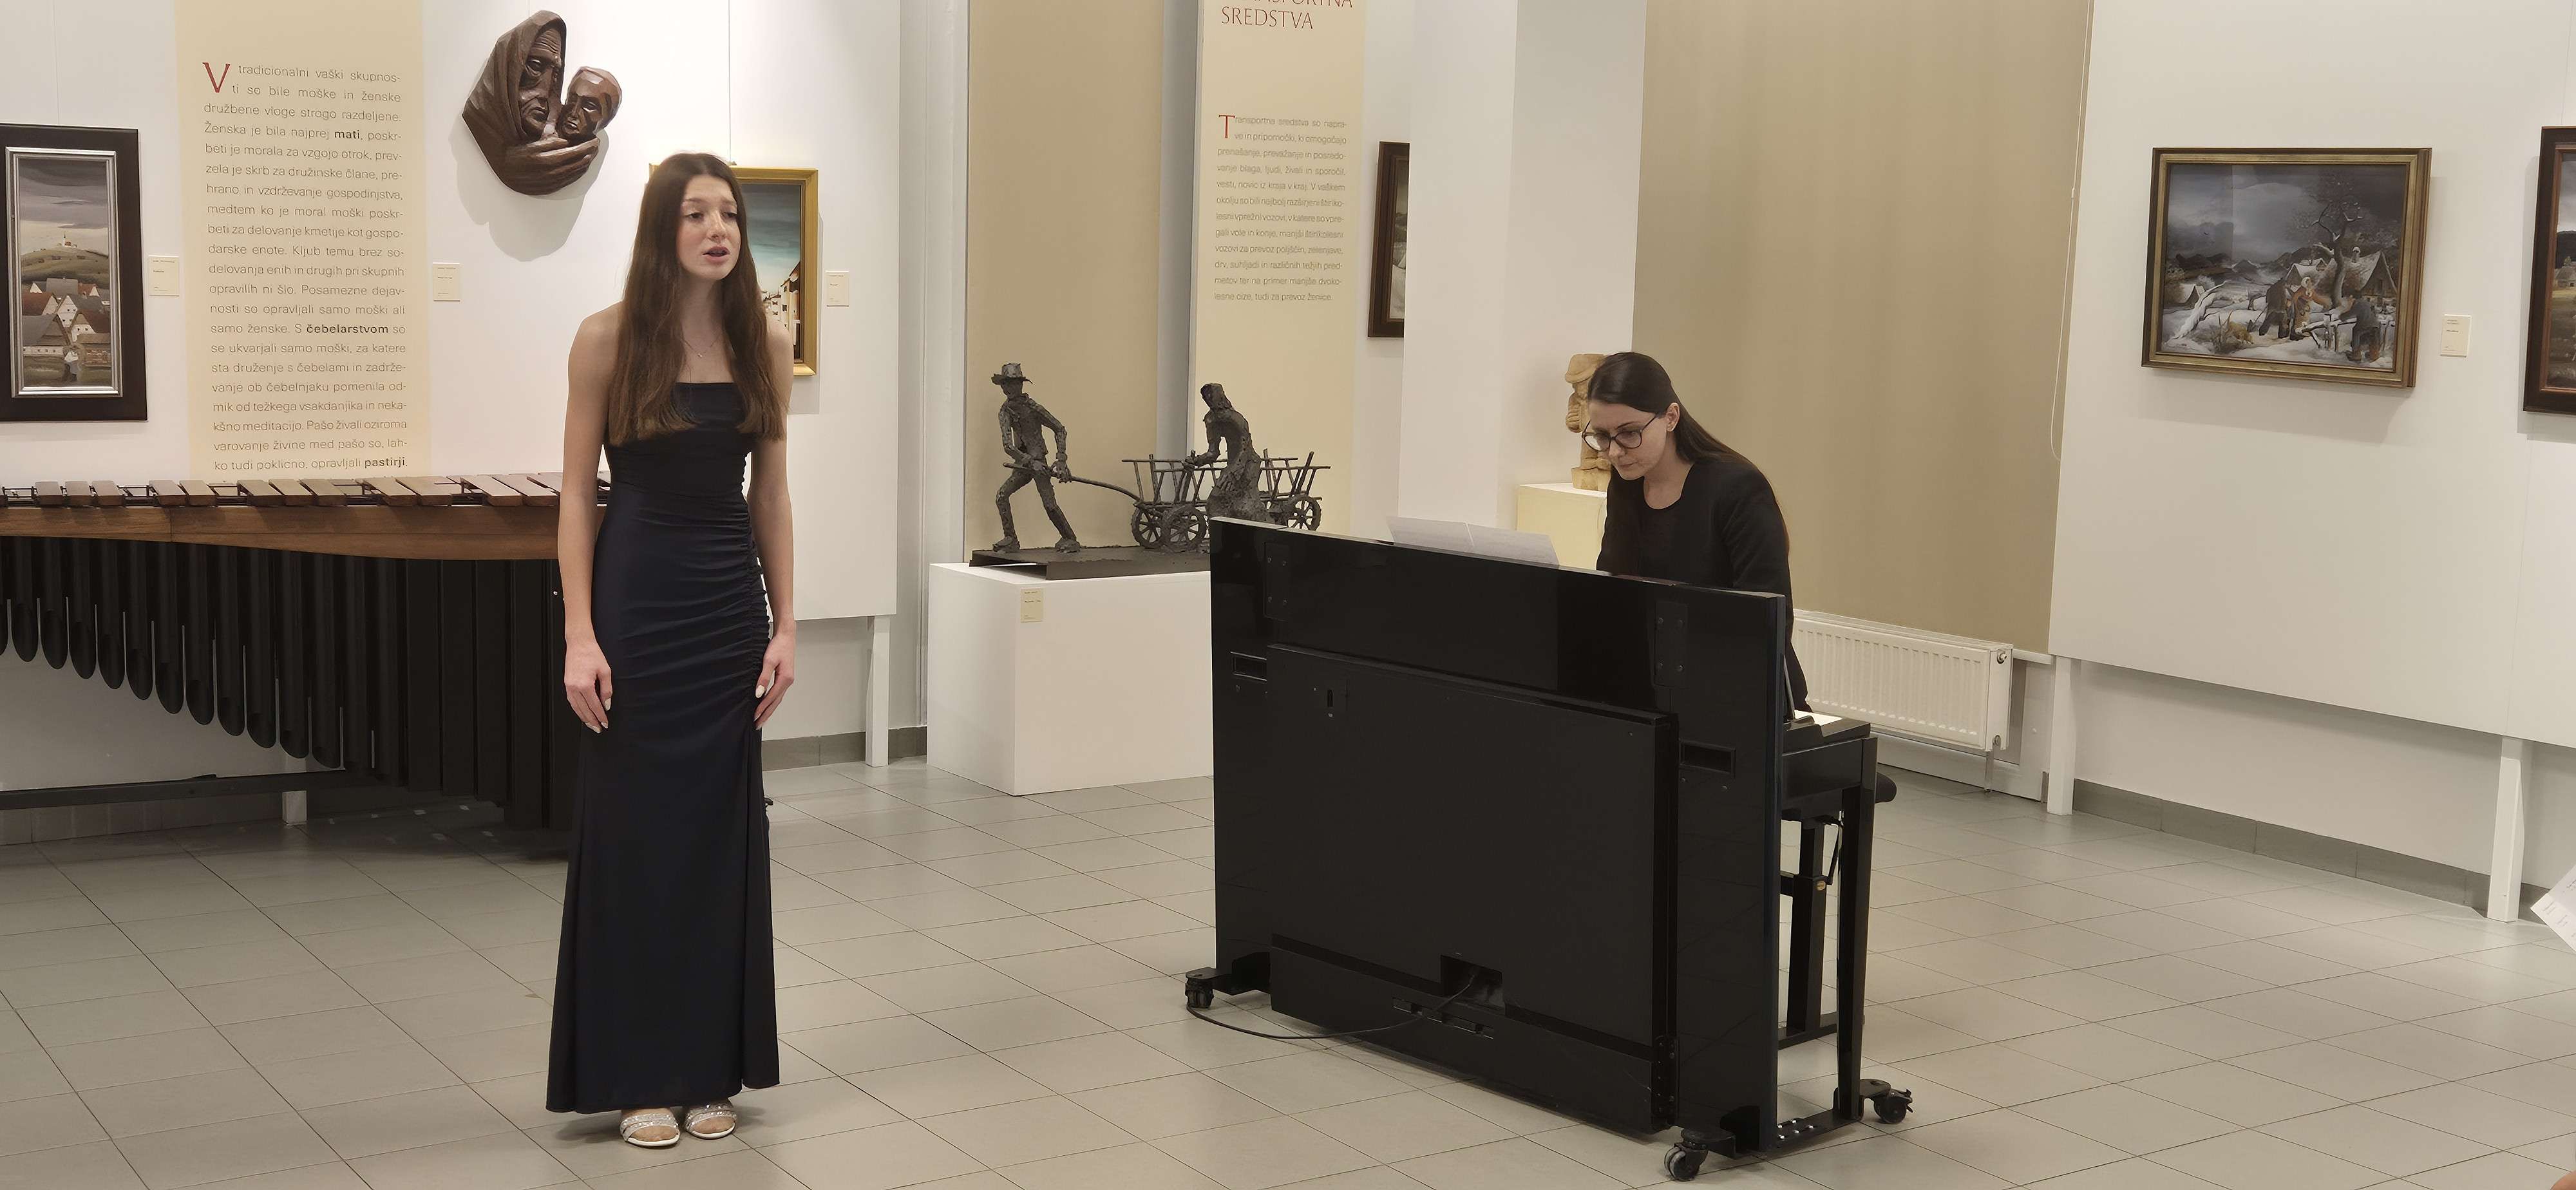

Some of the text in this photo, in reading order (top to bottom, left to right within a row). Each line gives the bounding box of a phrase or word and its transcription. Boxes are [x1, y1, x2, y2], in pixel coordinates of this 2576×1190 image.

[1221, 6, 1314, 30] SREDSTVA
[203, 62, 400, 93] V tradicionalni vaški skupnos-
[232, 82, 402, 101] ti so bile moške in ženske
[204, 100, 259, 115] družbene
[264, 103, 295, 118] vloge
[300, 105, 336, 120] strogo
[204, 121, 245, 135] Ženska
[251, 123, 261, 137] je
[266, 124, 285, 136] bila
[291, 124, 328, 139] najprej
[368, 128, 401, 142] poskr-
[205, 142, 227, 154] beti
[230, 142, 240, 156] je
[244, 143, 283, 156] morala
[286, 148, 298, 156] za
[301, 145, 337, 160] vzgojo
[375, 151, 401, 162] prev-
[205, 162, 229, 175] zela
[232, 163, 242, 176] je
[245, 163, 269, 176] skrb
[272, 167, 285, 176] za
[288, 164, 342, 178] družinske
[381, 171, 402, 182] pre-
[207, 182, 239, 194] hrano
[243, 183, 253, 195] in
[258, 184, 321, 199] vzdrževanje
[207, 202, 402, 220] medtem ko je moral moški poskr-
[207, 222, 403, 240] beti za delovanje kmetije kot gospo-
[208, 242, 247, 255] darske
[292, 243, 320, 258] Kljub
[326, 244, 353, 256] temu
[359, 245, 382, 257] brez
[387, 249, 404, 257] so-
[209, 262, 404, 278] delovanja enih in drugih pri skupnih
[209, 281, 257, 296] opravilih
[263, 282, 272, 294] ni
[301, 283, 367, 295] Posamezne
[372, 283, 404, 297] dejav-
[210, 301, 238, 314] nosti
[263, 302, 313, 316] opravljali
[319, 306, 350, 314] samo
[355, 303, 387, 314] moški
[392, 303, 404, 314] ali
[294, 321, 301, 334] S
[307, 321, 388, 334] čebelarstvom
[392, 326, 405, 334] so
[211, 345, 224, 353] se
[229, 341, 276, 355] ukvarjali
[372, 341, 406, 353] katere
[211, 360, 406, 373] sta druženje s čebelami in zadrže-
[211, 379, 406, 394] vanje ob čebelnjaku pomenila od-
[213, 399, 406, 413] mik od težkega vsakdanjika in neka-
[213, 419, 240, 431] kšno
[307, 418, 334, 430] Pašo
[336, 417, 361, 430] živali
[364, 417, 406, 430] oziroma
[213, 438, 269, 453] varovanje
[273, 438, 305, 450] živine
[309, 437, 334, 449] med
[338, 437, 365, 451] pašo
[387, 437, 407, 449] lah-
[214, 458, 227, 470] ko
[231, 458, 252, 470] tudi
[311, 457, 360, 471] opravljali
